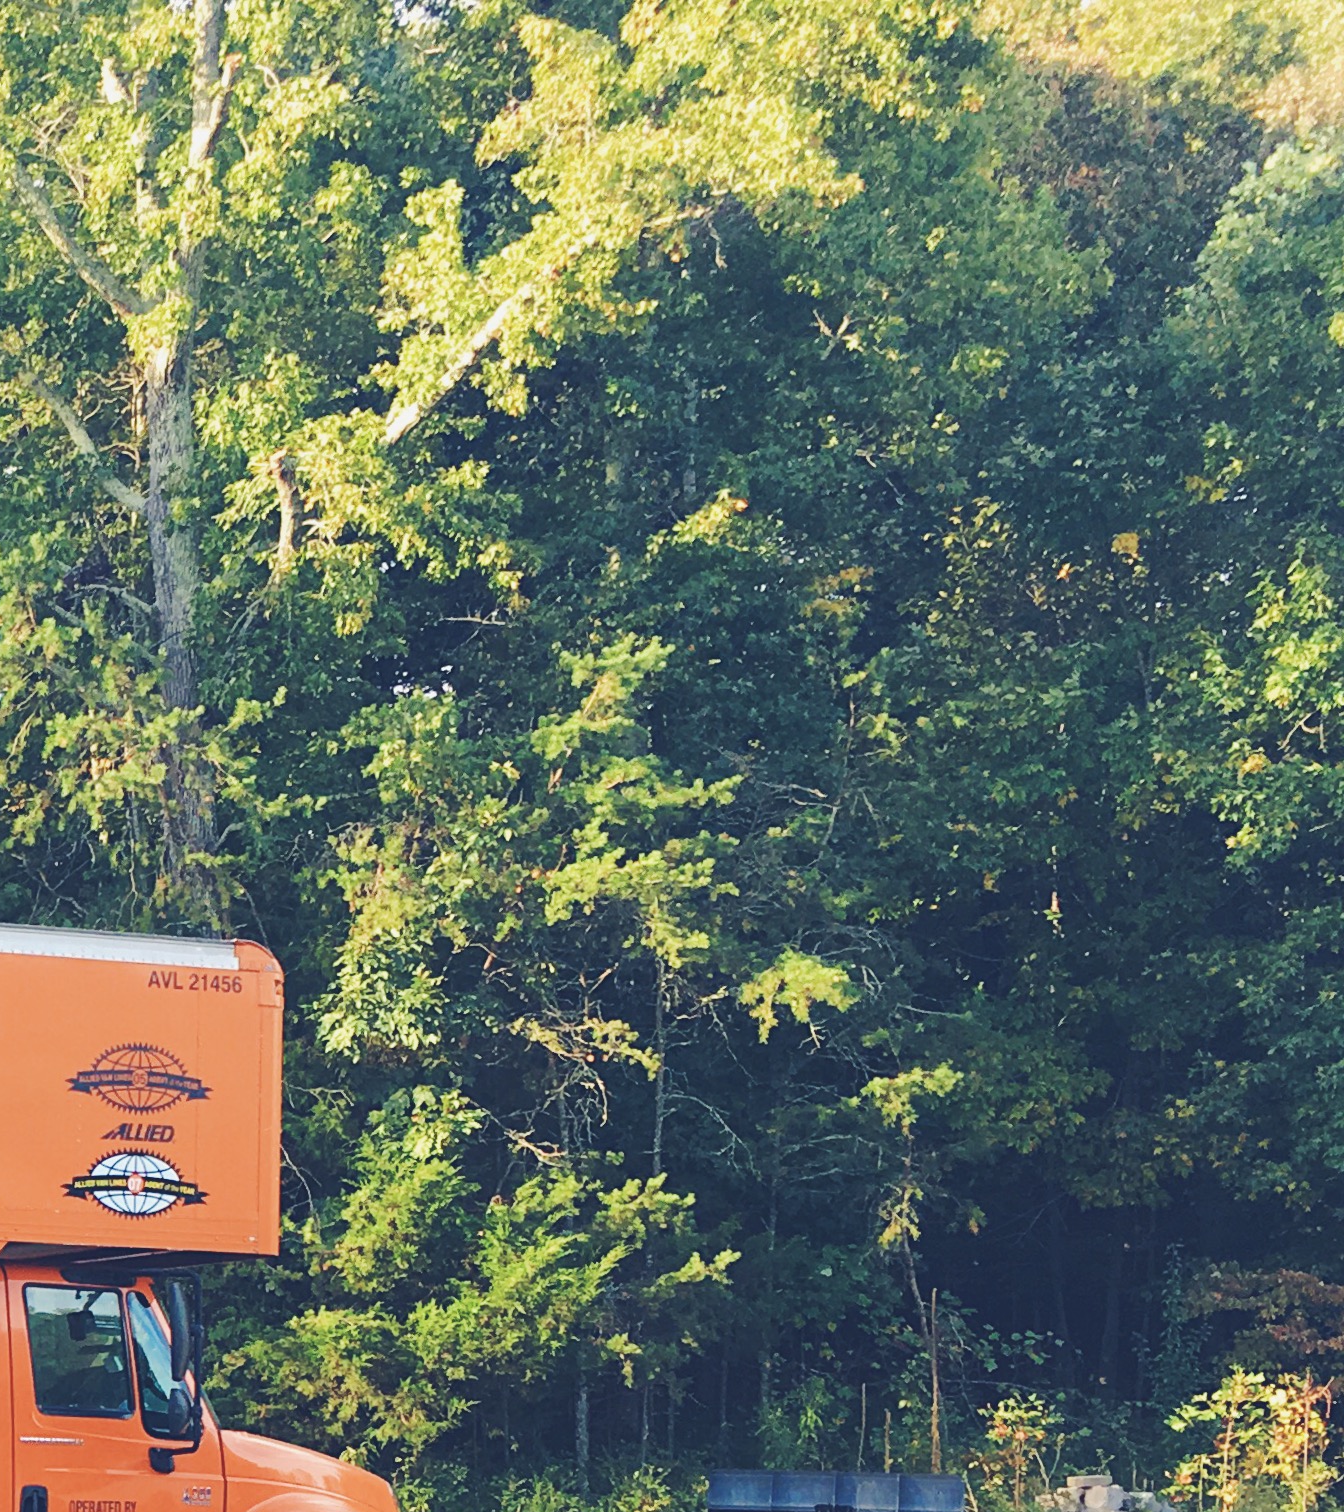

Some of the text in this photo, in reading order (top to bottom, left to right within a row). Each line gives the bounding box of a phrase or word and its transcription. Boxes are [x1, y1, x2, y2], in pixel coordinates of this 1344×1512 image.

[147, 970, 243, 994] AVL 21456
[100, 1123, 175, 1143] ALLIED
